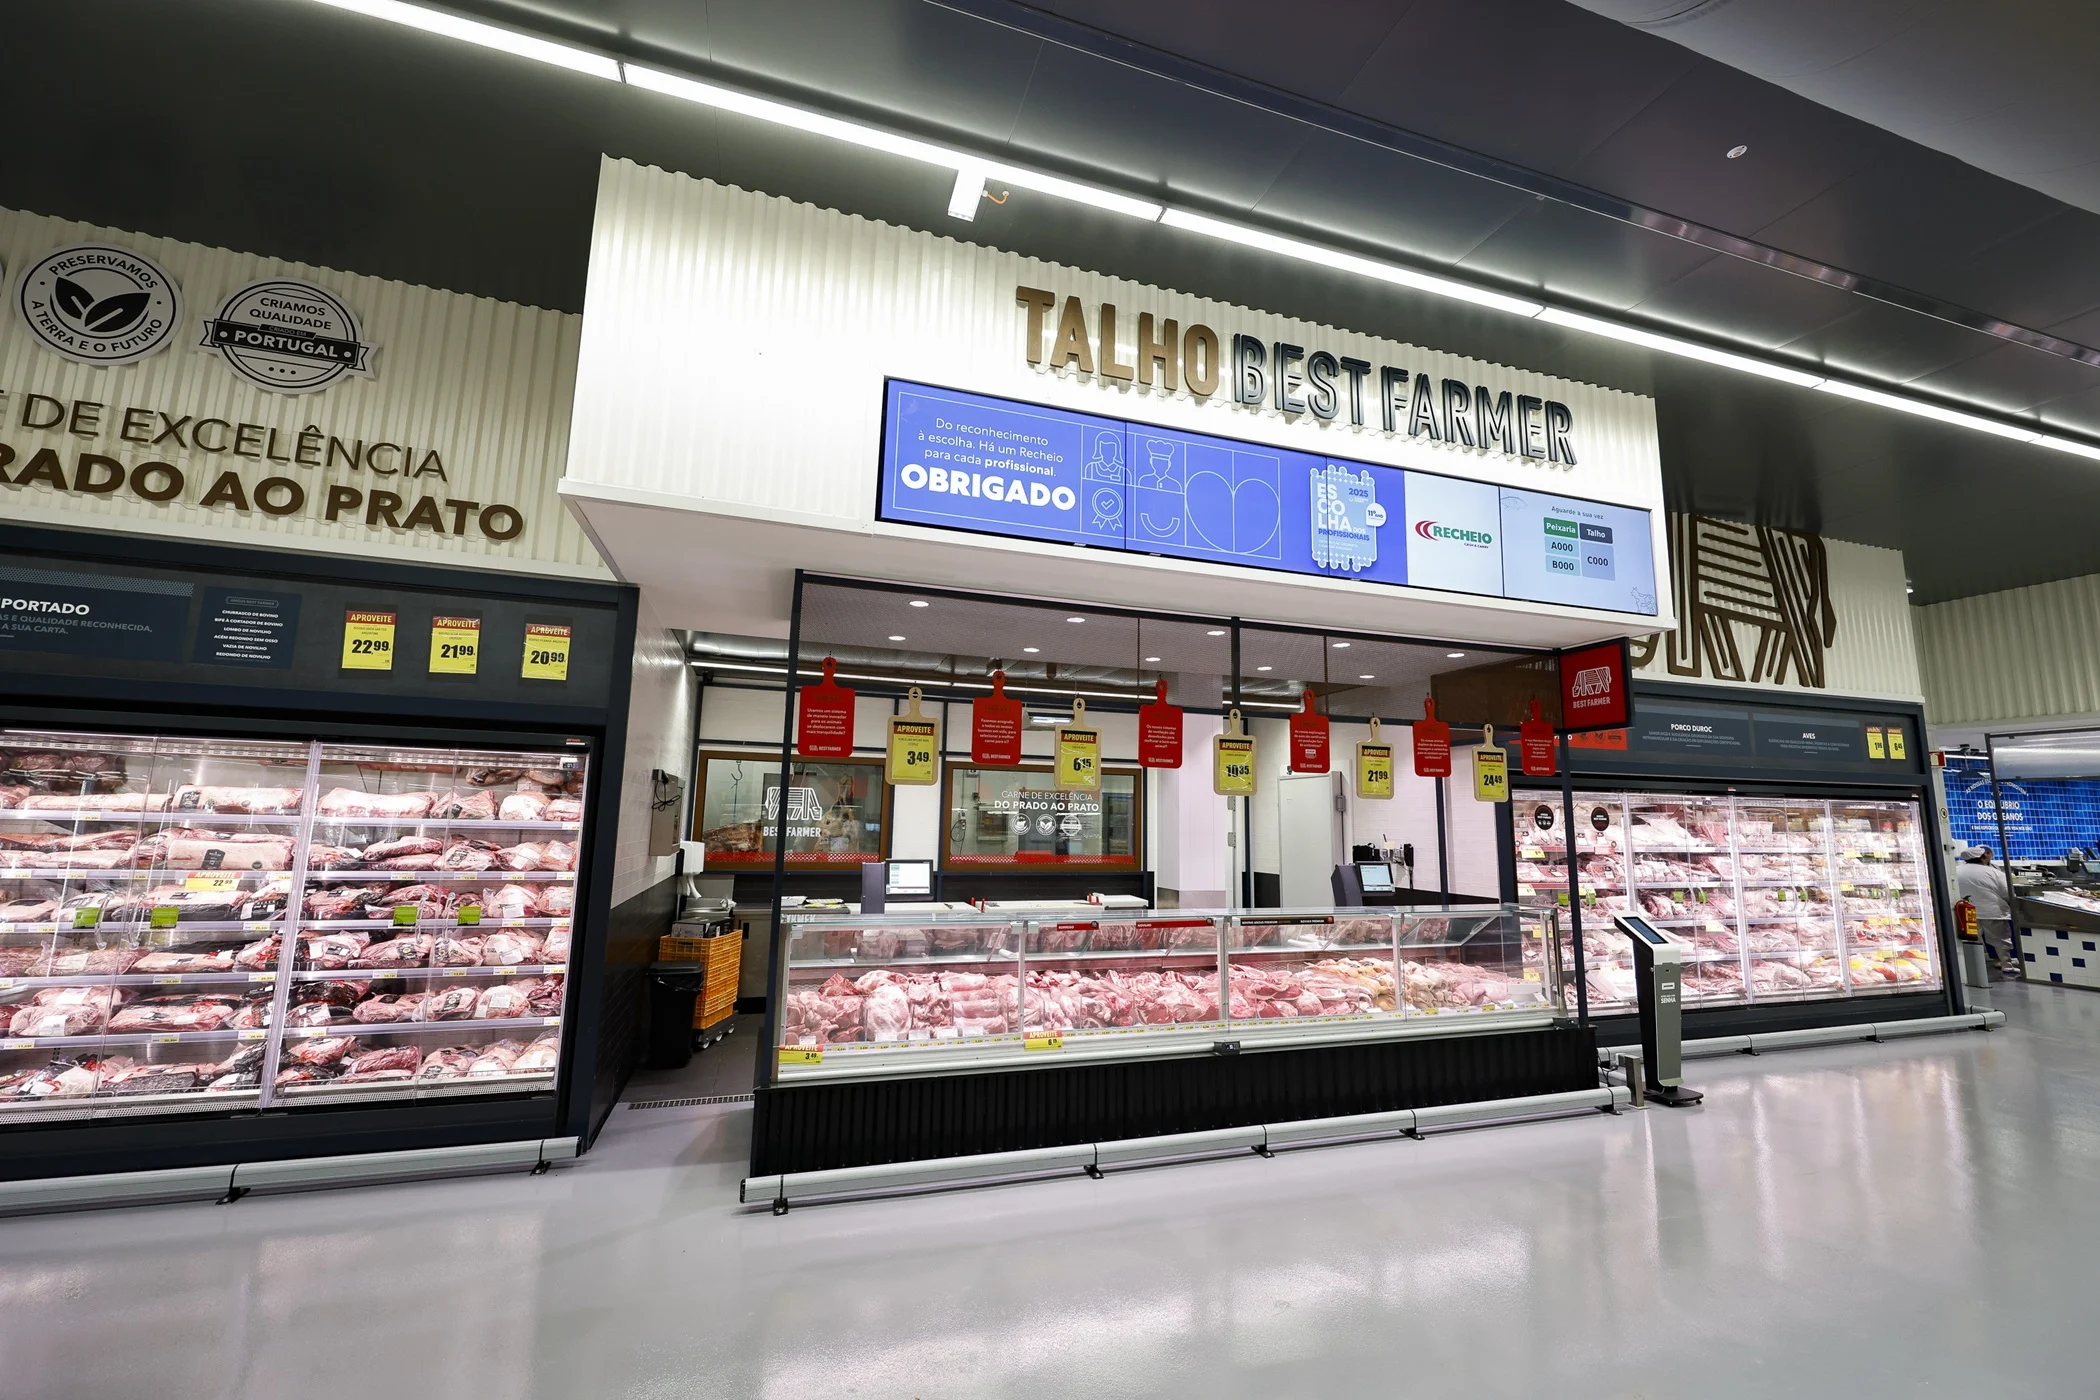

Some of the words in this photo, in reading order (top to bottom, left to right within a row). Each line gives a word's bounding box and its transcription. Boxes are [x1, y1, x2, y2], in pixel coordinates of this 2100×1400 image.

[49, 254, 158, 289] PRESERVAMOS
[32, 300, 44, 310] A
[260, 297, 326, 316] CRIAMOS
[250, 308, 332, 330] QUALIDADE
[36, 311, 74, 346] TERRA
[268, 326, 296, 335] CRIADO
[111, 319, 162, 352] FUTURO
[78, 340, 89, 350] E
[93, 342, 106, 352] O
[234, 330, 338, 358] PORTUGAL
[1016, 286, 1219, 396] TALHO
[1233, 333, 1371, 426] BEST
[1381, 366, 1578, 466] FARMER
[22, 393, 104, 436] DE
[120, 407, 448, 482] EXCELÊNCIA
[936, 418, 953, 430] Do
[956, 423, 1049, 446] reconhecimento
[918, 430, 925, 441] à
[928, 432, 976, 449] escolha.
[979, 440, 995, 452] Há
[998, 446, 1016, 456] um
[1020, 448, 1063, 463] Recheio
[924, 450, 950, 460] para
[954, 452, 981, 465] cada
[985, 458, 1056, 477] profissional.
[901, 464, 1076, 510] OBRIGADO
[1349, 488, 1368, 498] 2025
[199, 471, 304, 516] AO
[325, 484, 524, 540] PRATO
[1551, 506, 1576, 515] Aguarde
[1546, 522, 1576, 534] Peixaria
[1587, 529, 1606, 538] Talho
[1318, 528, 1370, 541] PROFISSIONAIS
[1433, 526, 1492, 544] RECHEIO
[1551, 542, 1573, 552] A000
[1552, 560, 1574, 571] B000
[1587, 556, 1608, 567] C000
[20, 615, 78, 627] QUALIDADE
[80, 620, 153, 632] RECONHECIDA,
[351, 613, 392, 623] APROVEITE
[437, 619, 476, 628] APROVEITE
[34, 625, 69, 634] CARTA.
[531, 626, 568, 636] APROVEITE
[1587, 697, 1611, 706] FARMER
[897, 725, 931, 734] APROVEITE
[1001, 791, 1030, 799] CARNE
[1044, 792, 1093, 801] EXCELÊNCIA
[994, 800, 1010, 809] DO
[1012, 801, 1048, 810] PRADO
[1978, 812, 1991, 820] DOS
[1992, 812, 2023, 821] OEANOS
[763, 826, 779, 837] BES
[786, 827, 821, 837] FARMER
